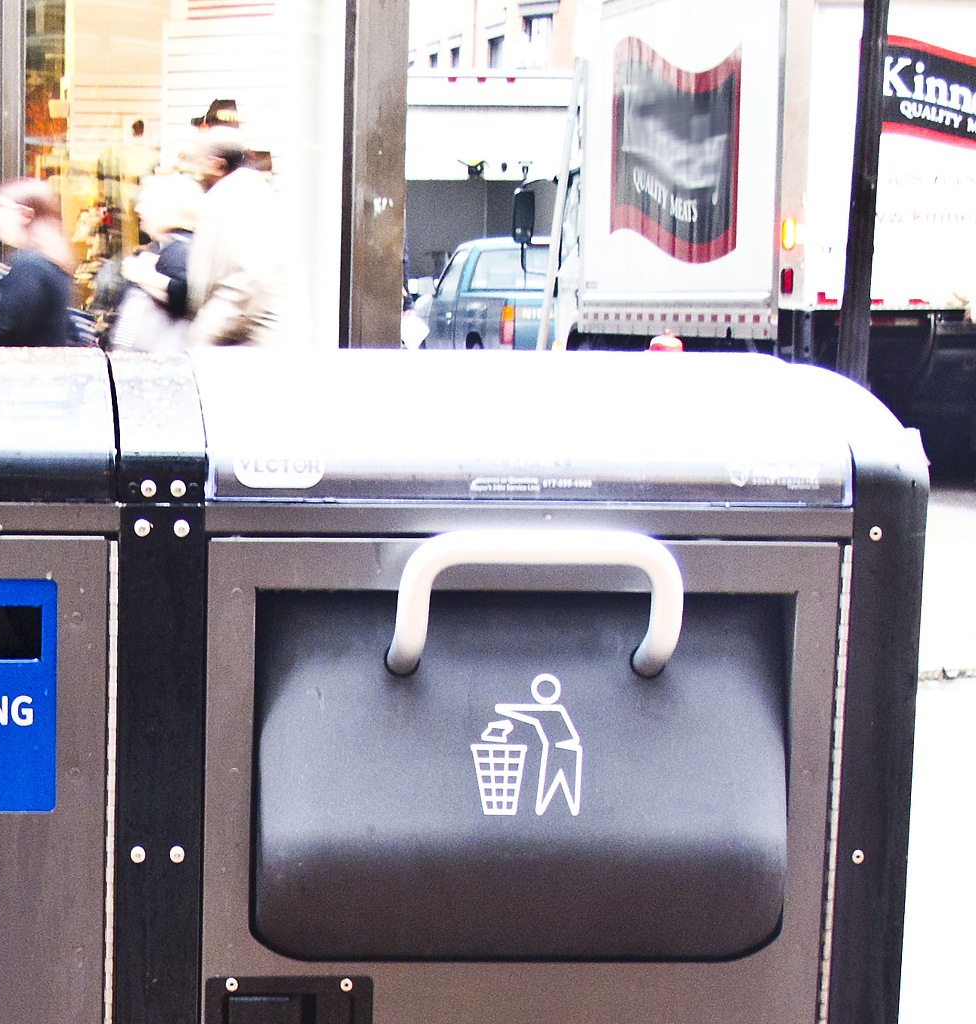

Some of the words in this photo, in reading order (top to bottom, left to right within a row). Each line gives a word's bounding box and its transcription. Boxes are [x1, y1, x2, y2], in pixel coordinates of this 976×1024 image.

[882, 56, 976, 115] Kinn
[899, 100, 962, 129] QUALITY
[633, 166, 667, 210] QUALITY
[670, 192, 698, 223] MEATS
[240, 459, 322, 473] VECTOR
